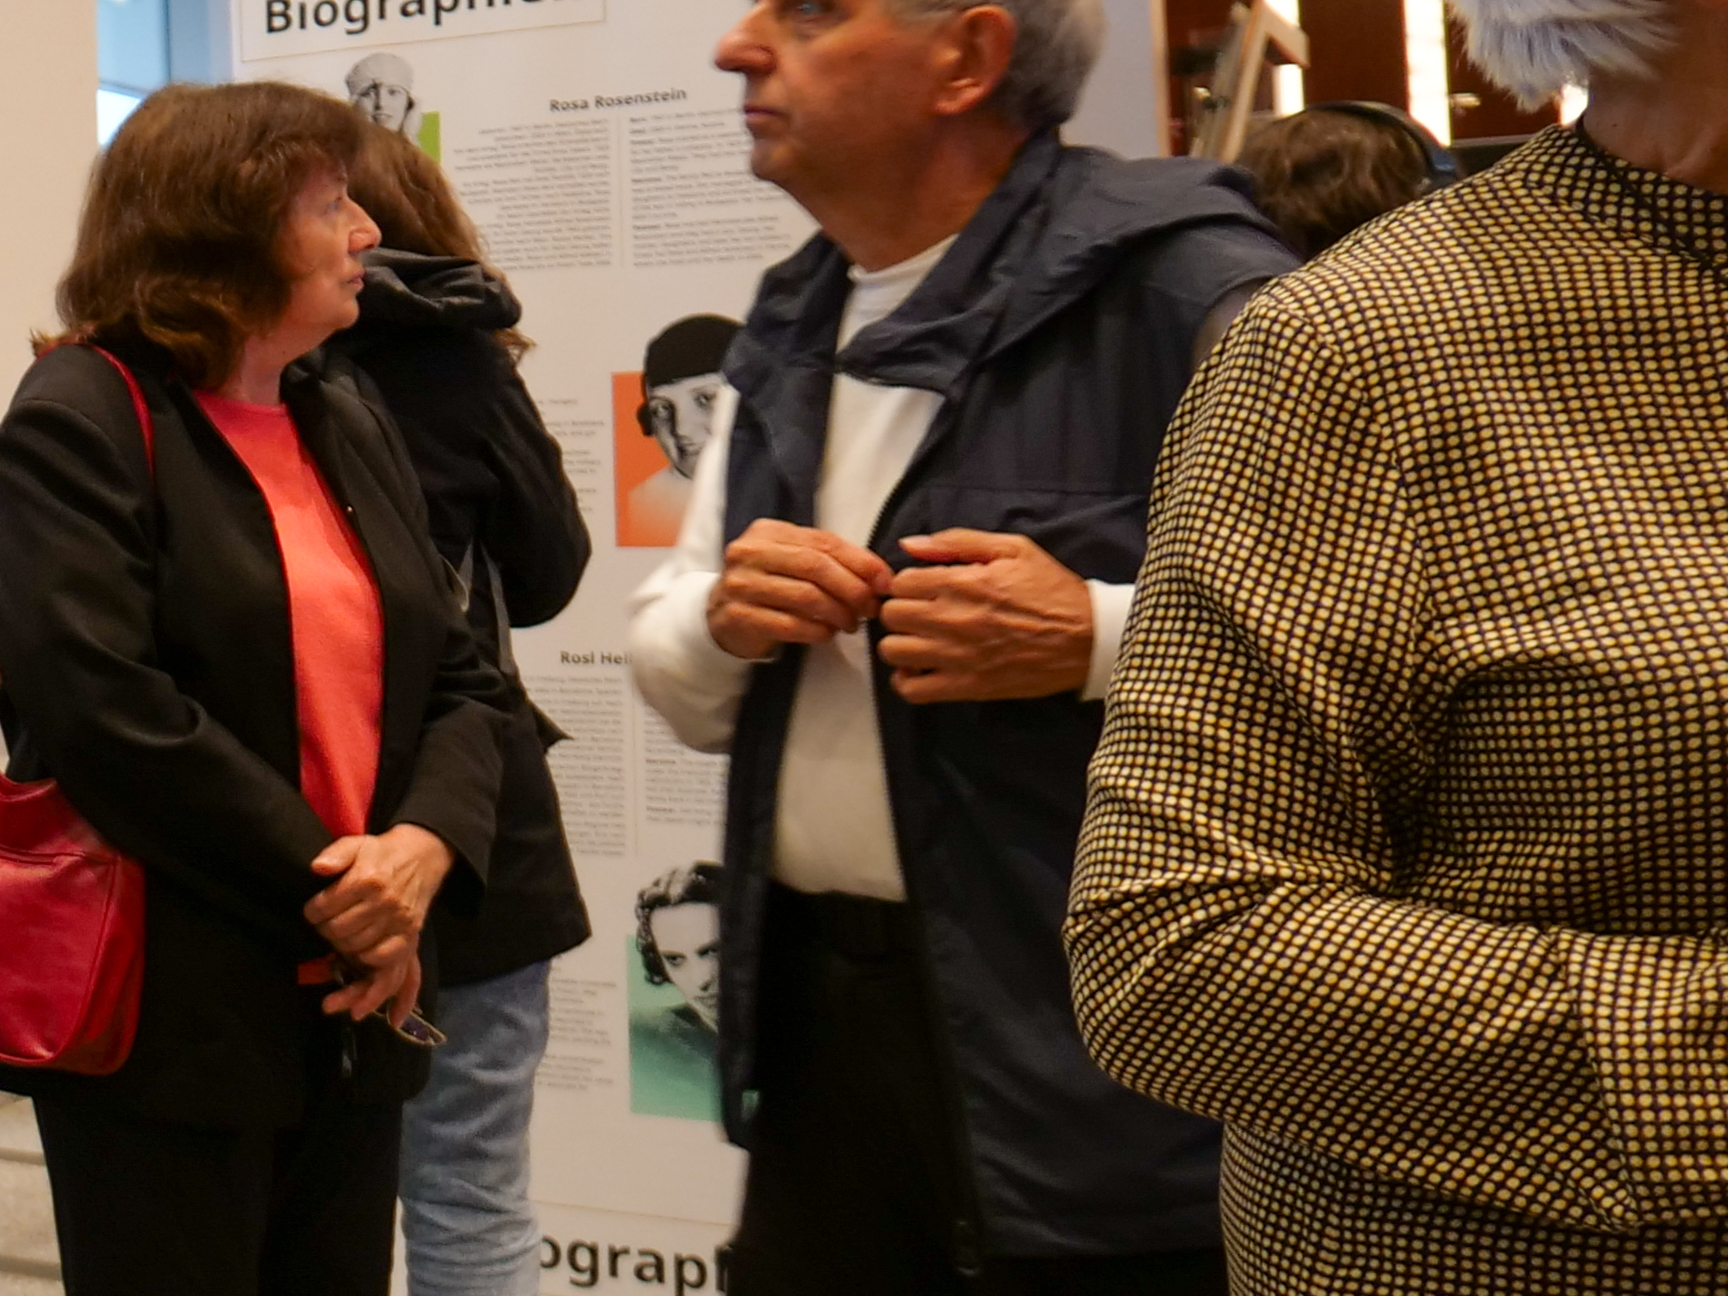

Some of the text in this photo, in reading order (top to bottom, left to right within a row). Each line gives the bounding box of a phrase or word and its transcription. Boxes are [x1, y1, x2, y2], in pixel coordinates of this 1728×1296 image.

[549, 87, 688, 113] Rosa Rosenstein
[560, 650, 595, 665] Rosl
